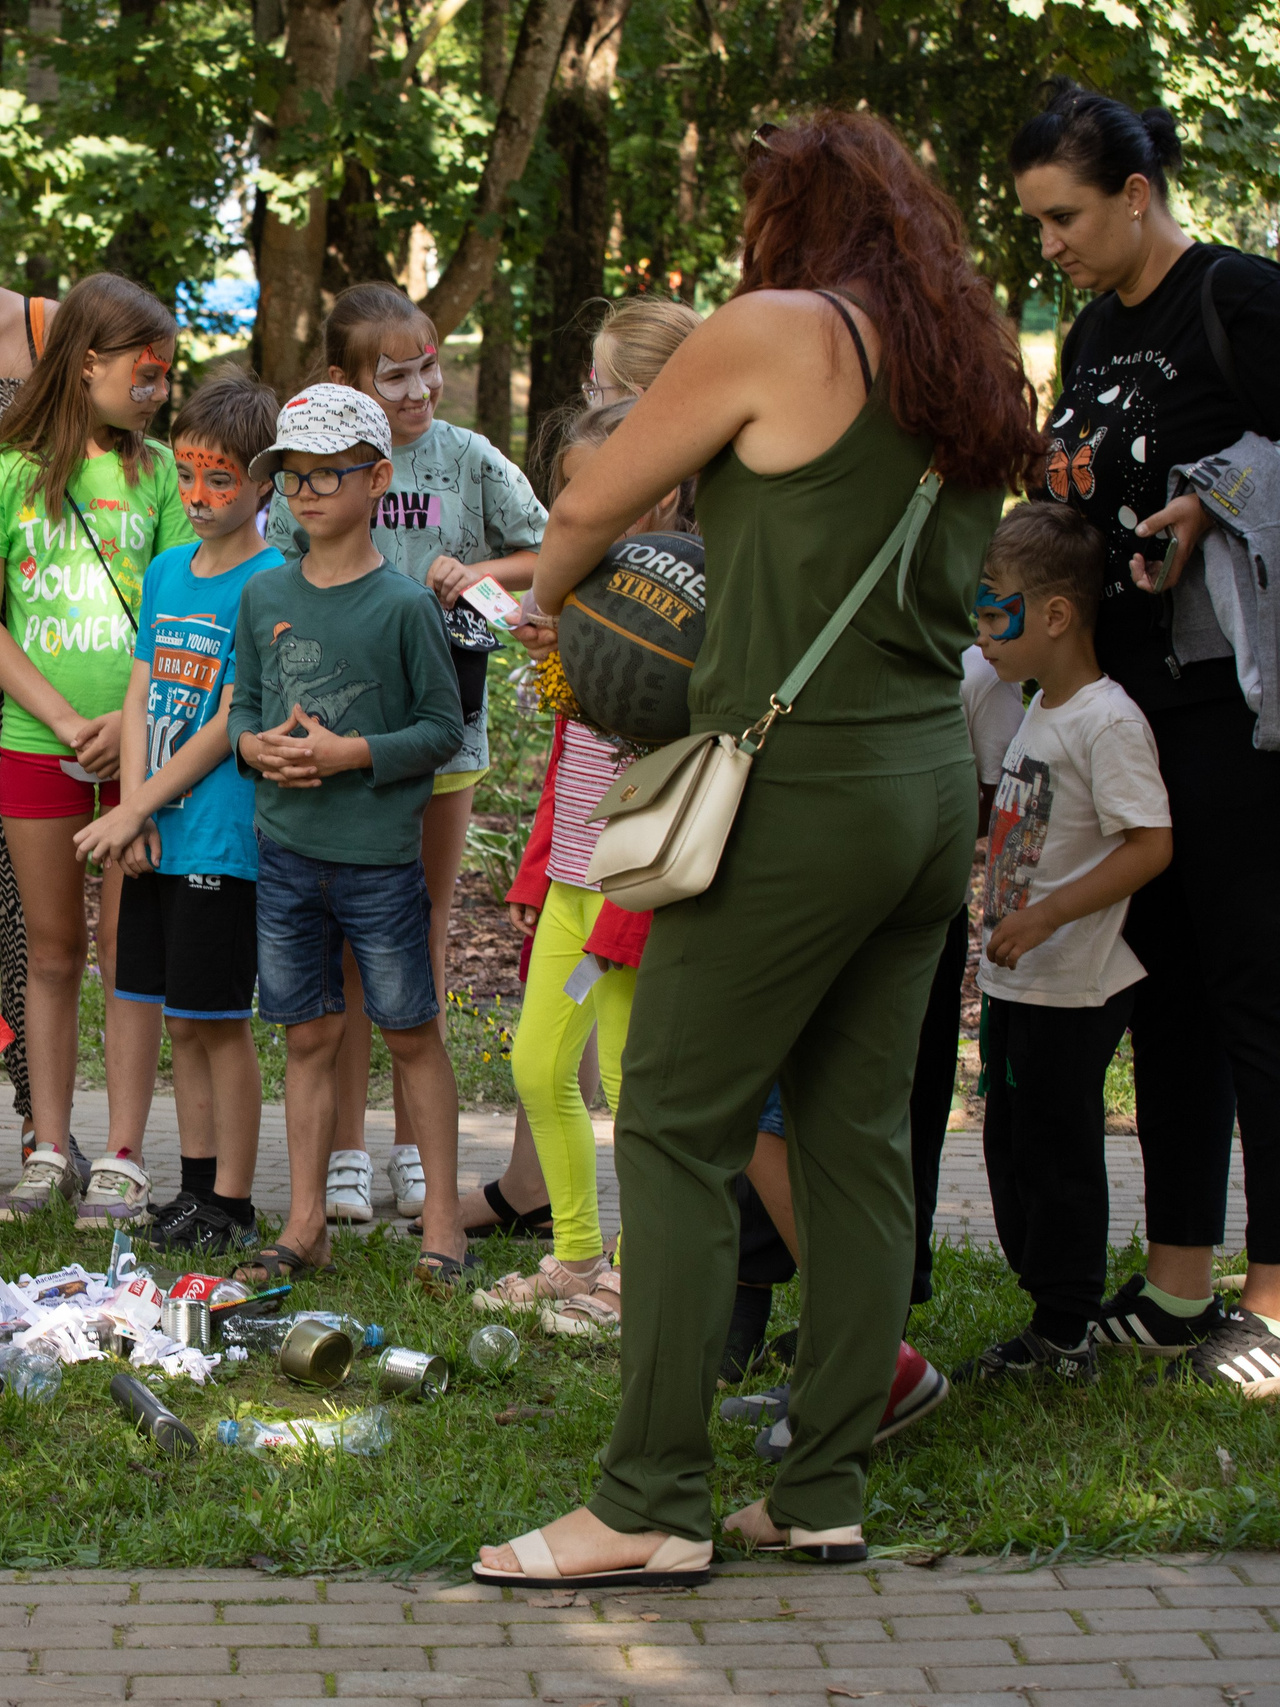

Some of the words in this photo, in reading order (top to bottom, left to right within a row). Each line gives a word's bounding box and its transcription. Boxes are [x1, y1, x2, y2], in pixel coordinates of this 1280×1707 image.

[1111, 351, 1142, 365] MADE
[326, 409, 343, 418] FILA
[340, 420, 357, 429] FILA
[323, 424, 341, 432] FILA
[120, 512, 146, 550] IS
[608, 571, 692, 625] STREET
[22, 613, 131, 655] POWER
[186, 632, 221, 655] YOUNG
[158, 656, 181, 674] URBA
[183, 661, 218, 684] CITY
[165, 687, 173, 714] SINCE
